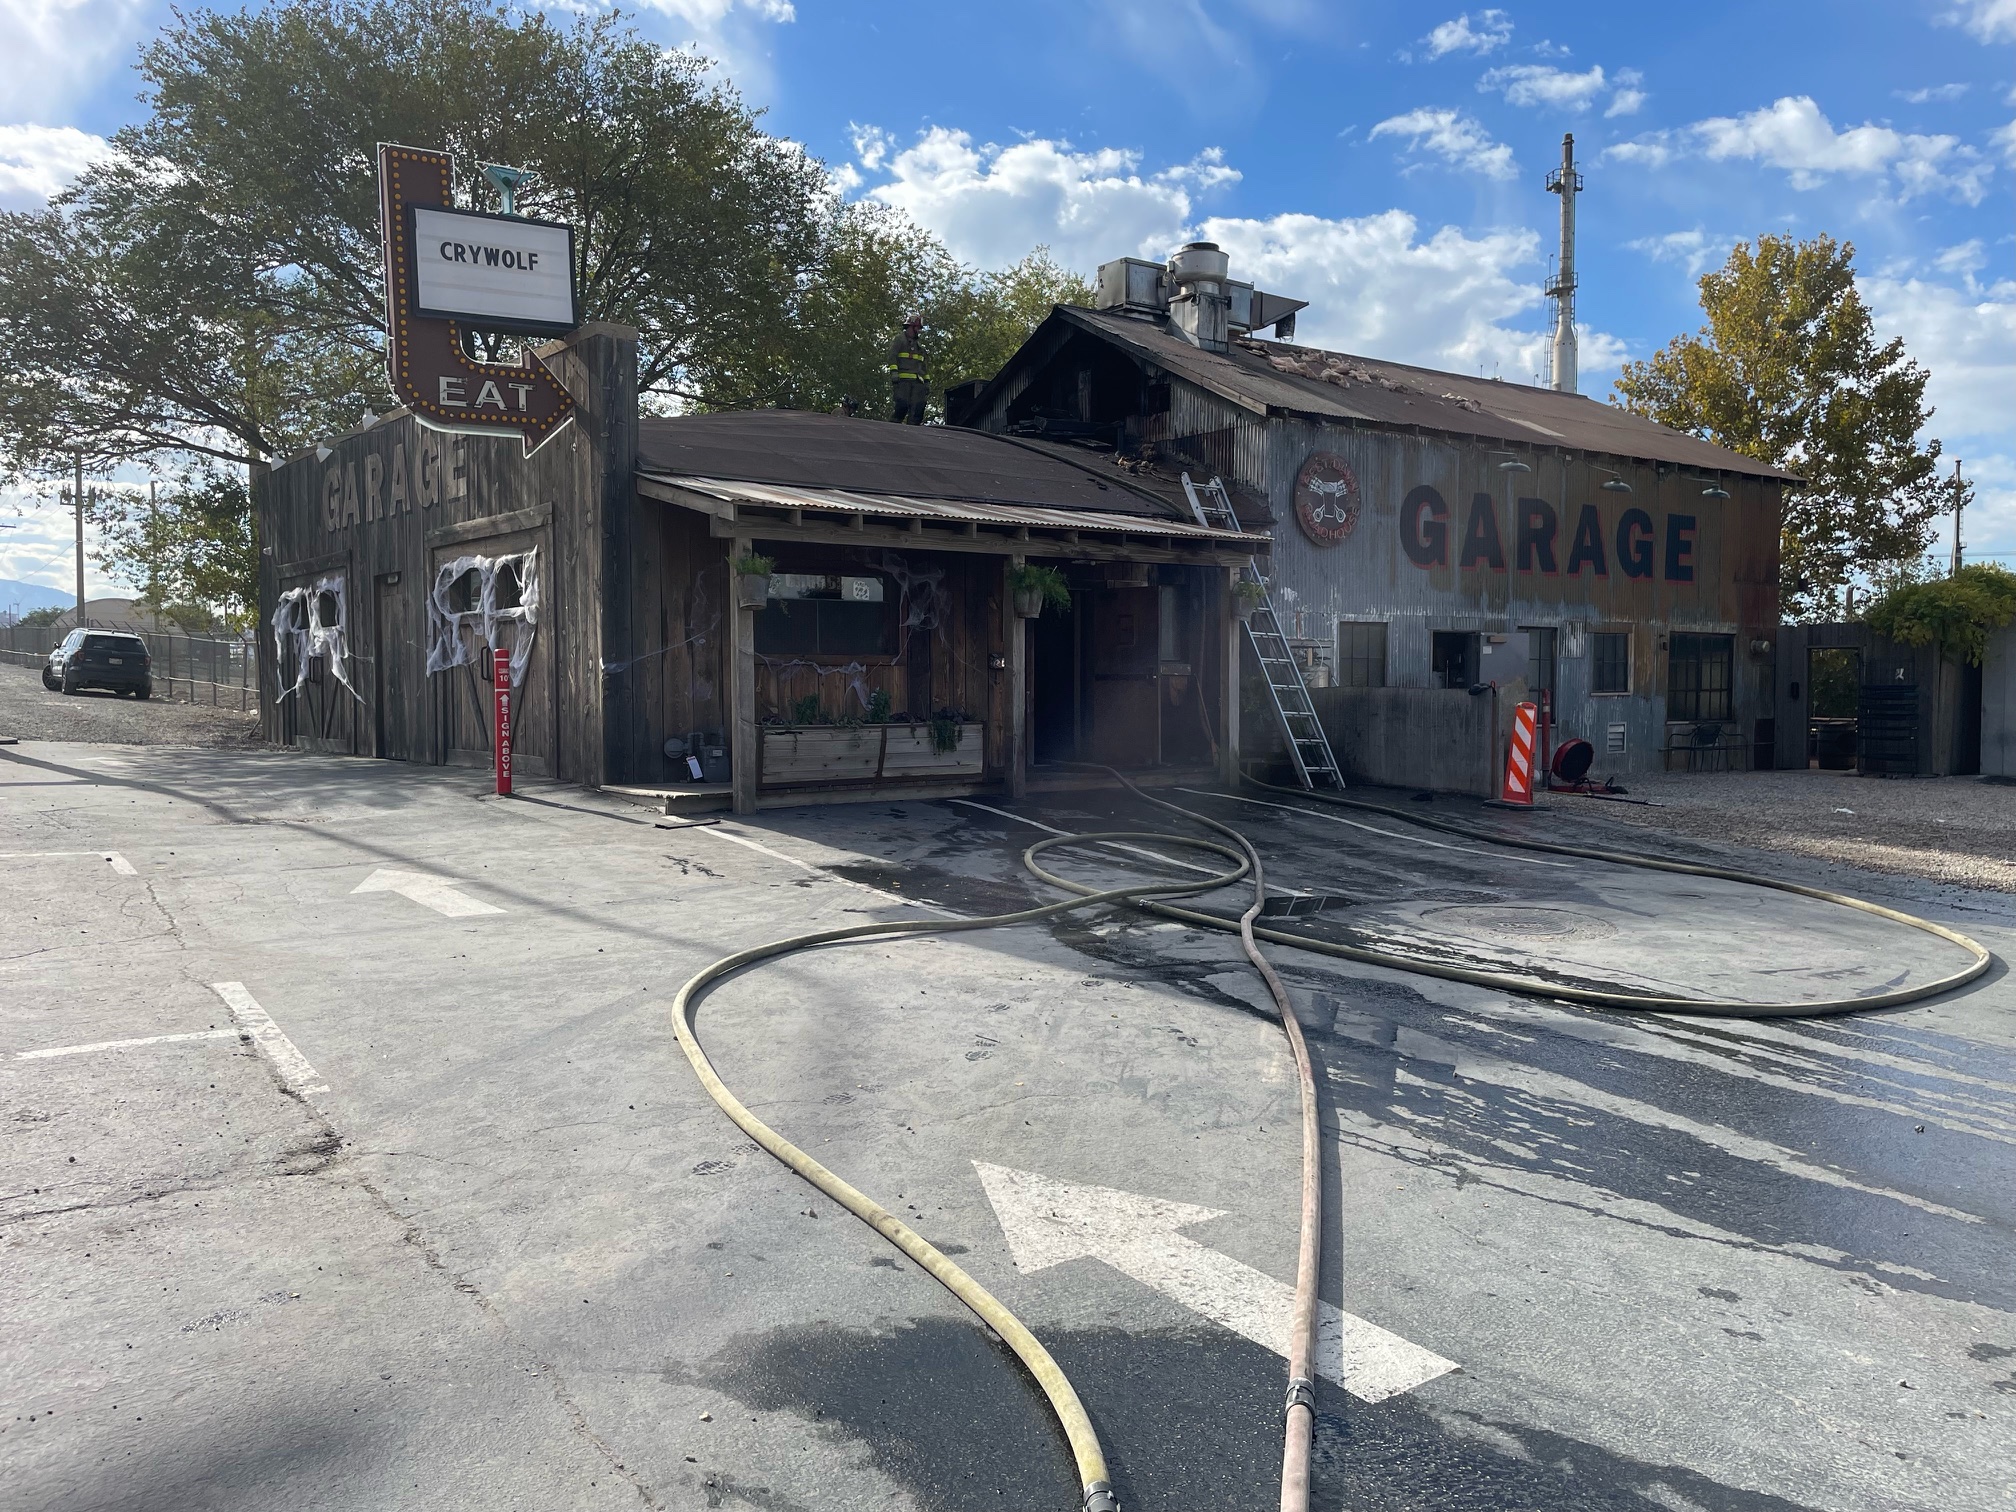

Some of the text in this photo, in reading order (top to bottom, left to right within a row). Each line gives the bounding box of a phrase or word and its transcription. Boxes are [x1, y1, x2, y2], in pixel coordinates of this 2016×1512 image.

[440, 241, 538, 271] CRYWOLF
[439, 376, 536, 412] EAT
[322, 433, 467, 532] GARAGE
[1400, 484, 1697, 586] GARAGE
[501, 706, 510, 778] SIGN ABOVE
